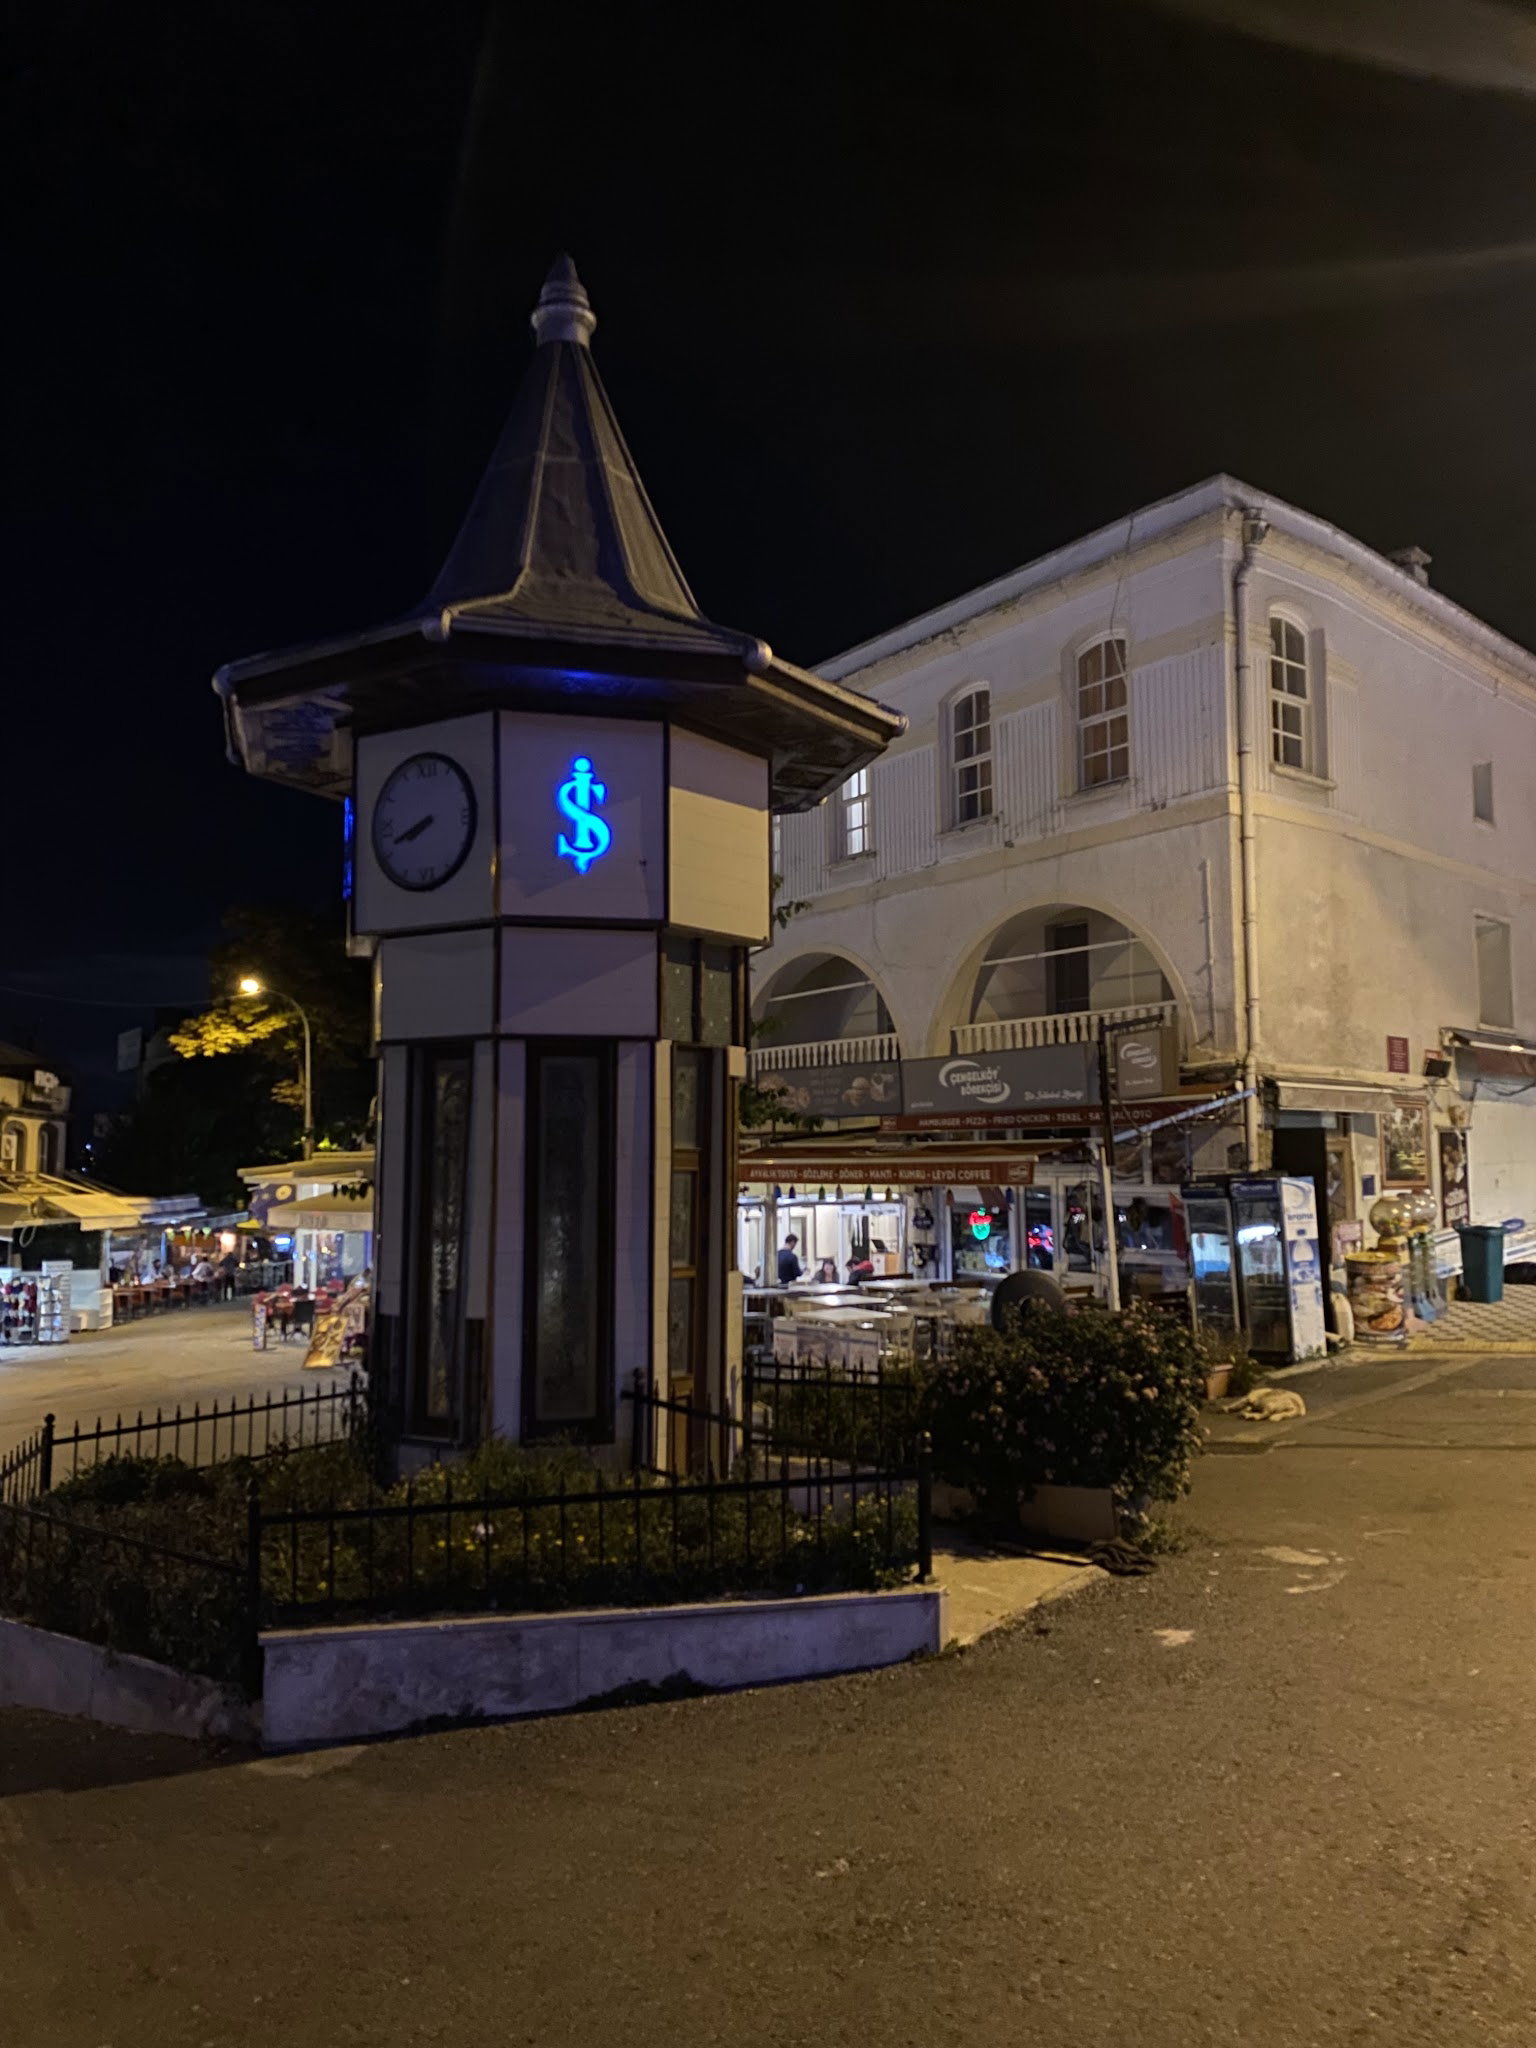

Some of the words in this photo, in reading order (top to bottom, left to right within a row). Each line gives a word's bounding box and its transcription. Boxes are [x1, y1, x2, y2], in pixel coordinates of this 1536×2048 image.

[919, 1117, 960, 1126] HAMBURGER
[750, 1168, 776, 1178] AYVALIK
[802, 1167, 833, 1180] GÖZLEME
[839, 1167, 864, 1180] DÖNER
[931, 1167, 957, 1181] LEYDİ
[957, 1169, 991, 1181] COFFEE
